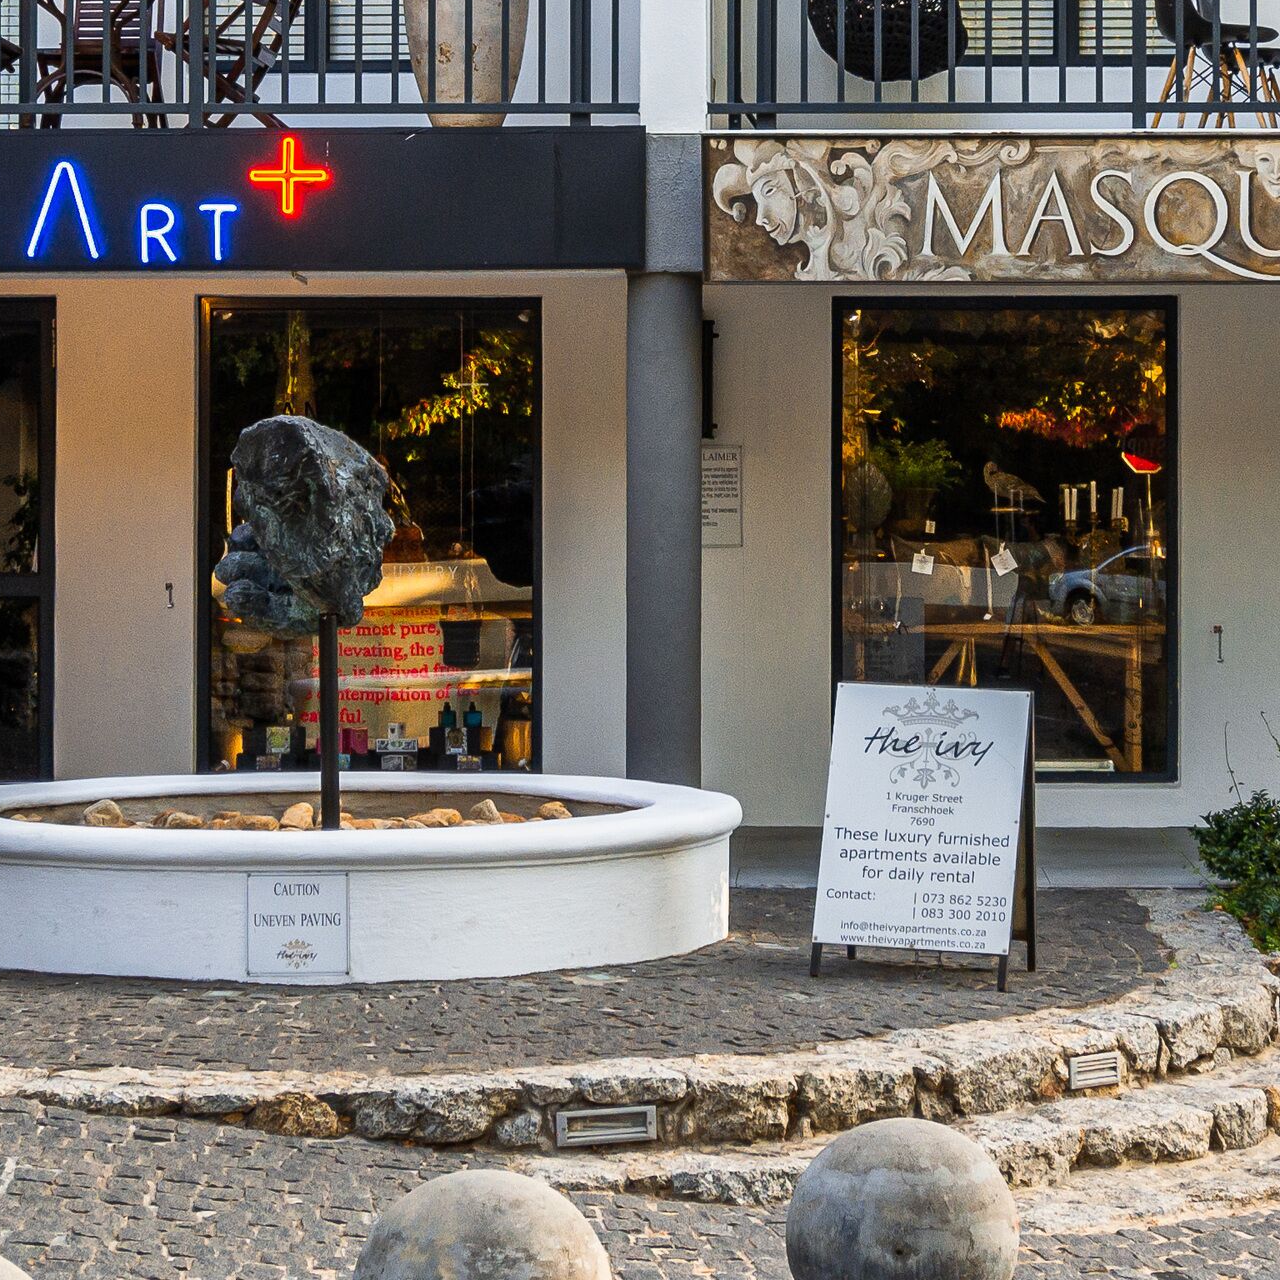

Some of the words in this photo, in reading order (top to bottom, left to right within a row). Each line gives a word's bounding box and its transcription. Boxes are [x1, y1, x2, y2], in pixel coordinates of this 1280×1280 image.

[702, 452, 738, 461] LAIMER
[392, 566, 458, 580] UXURY
[355, 624, 396, 636] most
[400, 623, 440, 639] pure,
[338, 643, 408, 661] levating,
[410, 642, 434, 656] the
[316, 688, 431, 705] ntemplation
[435, 683, 451, 700] of
[936, 731, 993, 766] ivy
[887, 792, 891, 800] 1
[895, 792, 929, 803] Kruger
[932, 794, 963, 804] Street
[892, 804, 955, 815] Franschhoek
[911, 817, 935, 826] 7690
[834, 827, 878, 841] These
[885, 829, 932, 846] luxury
[938, 832, 1010, 847] furnished
[839, 848, 927, 862] apartments
[933, 852, 1001, 866] available
[862, 866, 883, 879] for
[889, 867, 924, 884] daily
[930, 871, 975, 883] rental
[273, 882, 320, 896] CAUTION
[826, 889, 876, 900] Contact:
[922, 893, 945, 904] 073
[949, 894, 972, 906] 862
[977, 896, 1007, 907] 5230
[254, 913, 296, 927] UNEVEN
[300, 912, 341, 926] PAVING
[921, 908, 944, 919] 083
[949, 909, 970, 920] 300
[976, 911, 1006, 922] 2010
[840, 921, 987, 937] info@theivyapartments.co.za
[840, 934, 986, 950] www.theivyapartments.co.za
